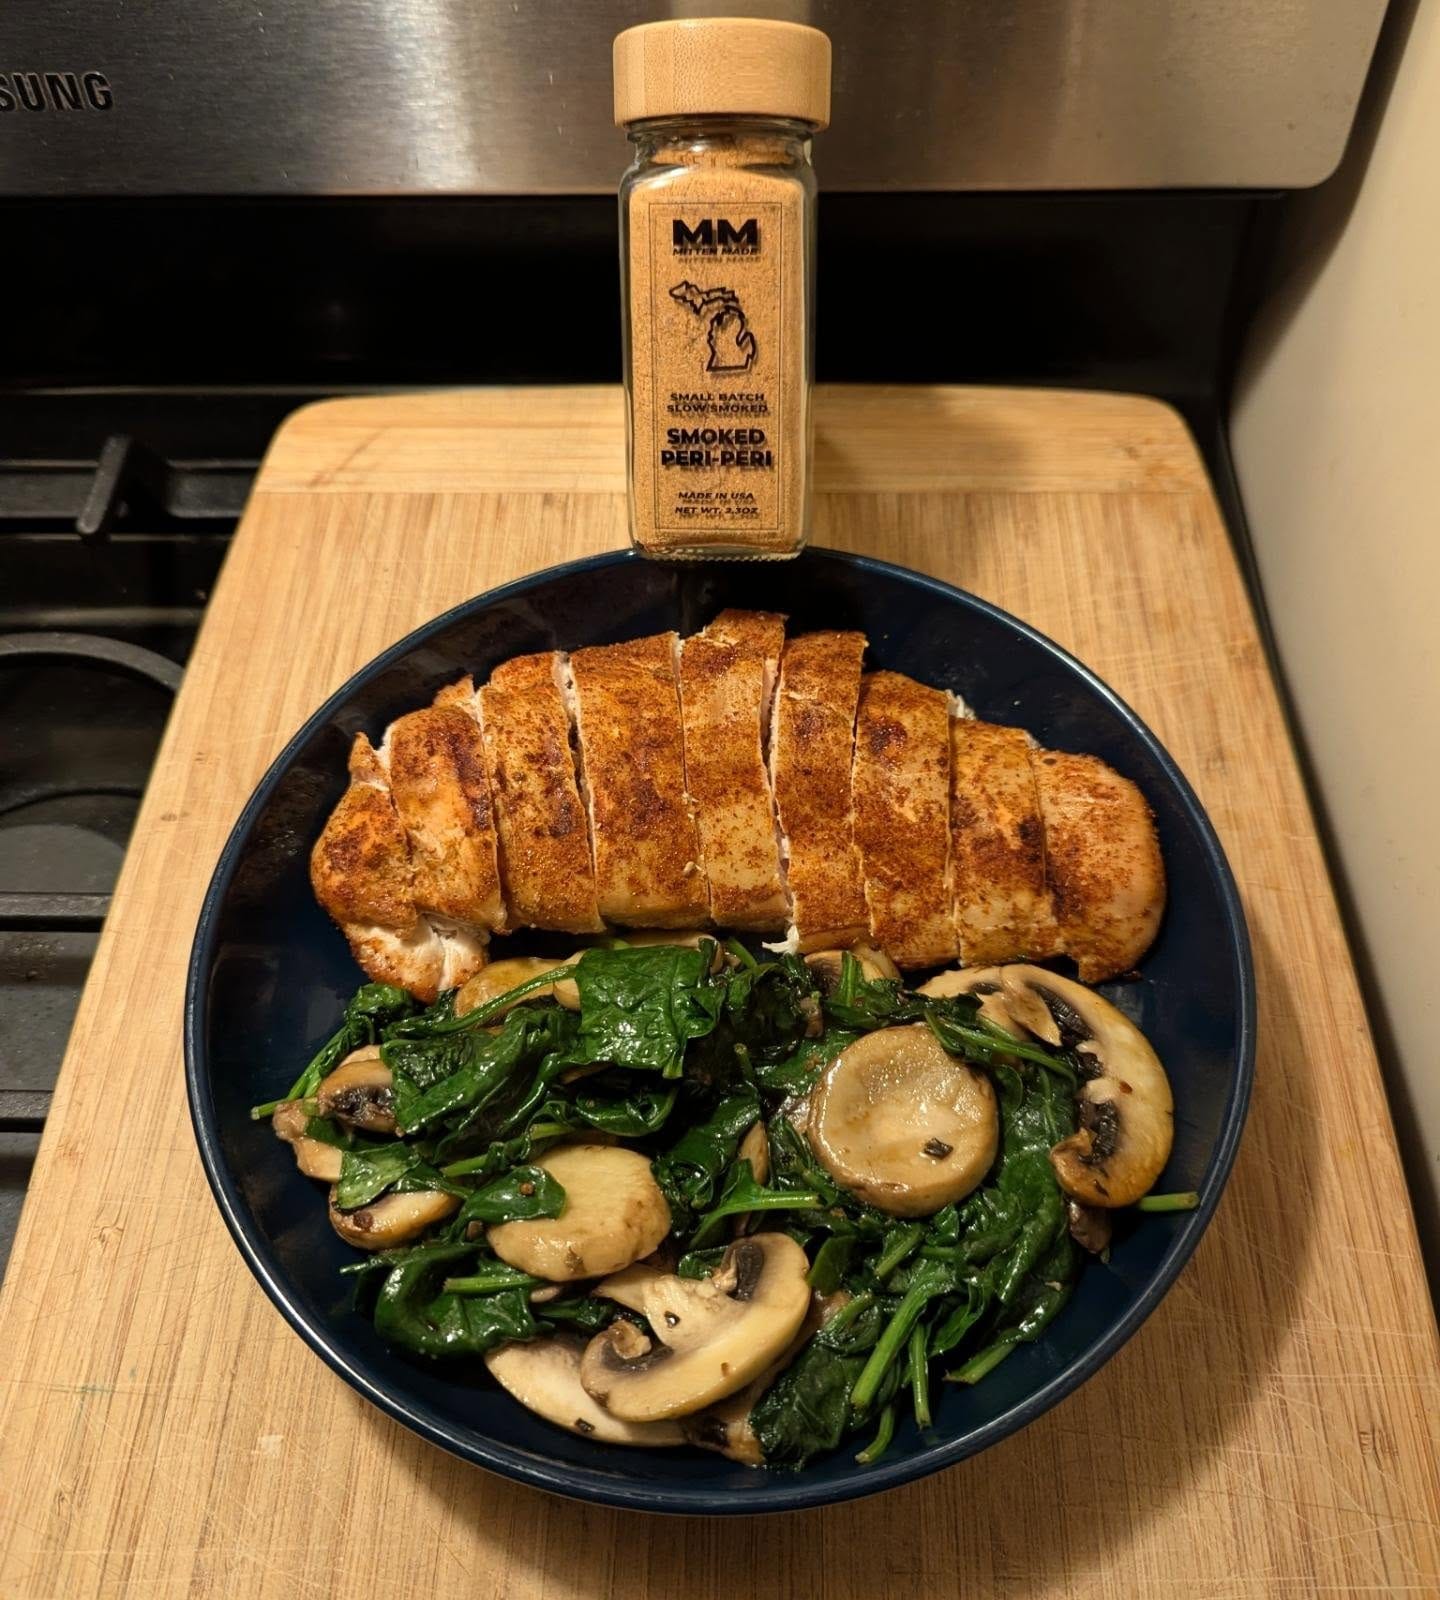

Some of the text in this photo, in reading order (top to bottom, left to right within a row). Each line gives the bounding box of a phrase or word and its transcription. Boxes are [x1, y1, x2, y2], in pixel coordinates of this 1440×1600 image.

[672, 218, 758, 246] MM
[721, 247, 758, 255] MADE
[670, 393, 765, 401] SMALL BATCH
[667, 404, 768, 413] SLOW SMOKED
[667, 428, 766, 445] SMOKED
[661, 450, 772, 467] PERI-PERI
[675, 506, 698, 514] NET
